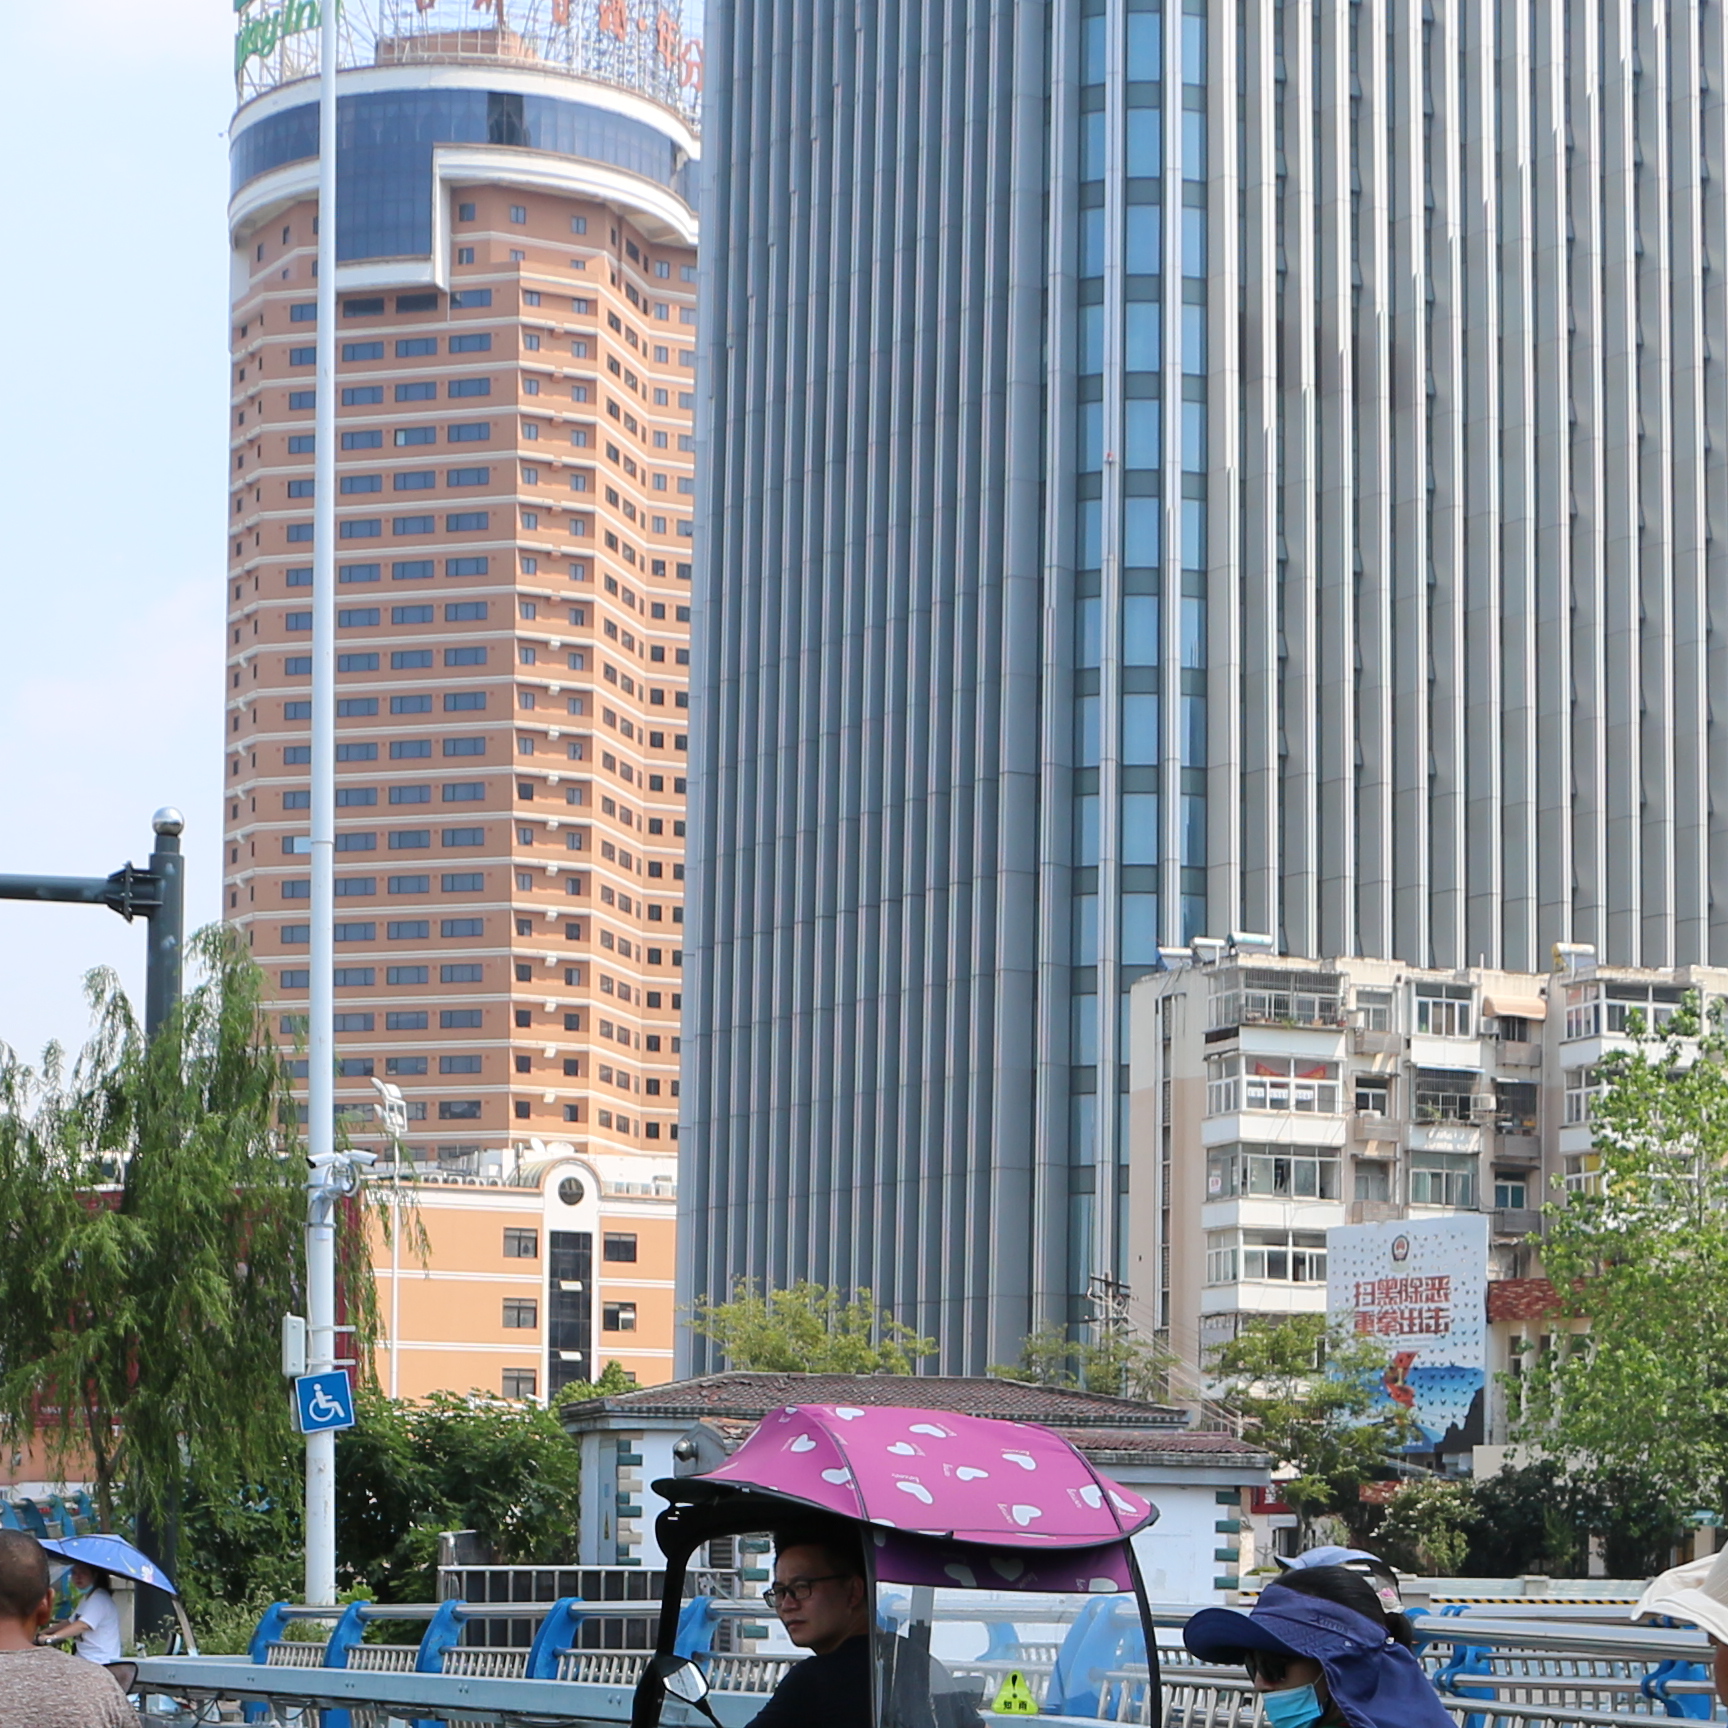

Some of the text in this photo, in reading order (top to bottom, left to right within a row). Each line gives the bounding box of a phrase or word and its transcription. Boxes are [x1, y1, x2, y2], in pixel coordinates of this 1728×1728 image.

[1353, 1275, 1451, 1307] 扫黑除恶
[1353, 1306, 1451, 1336] 重拳出击
